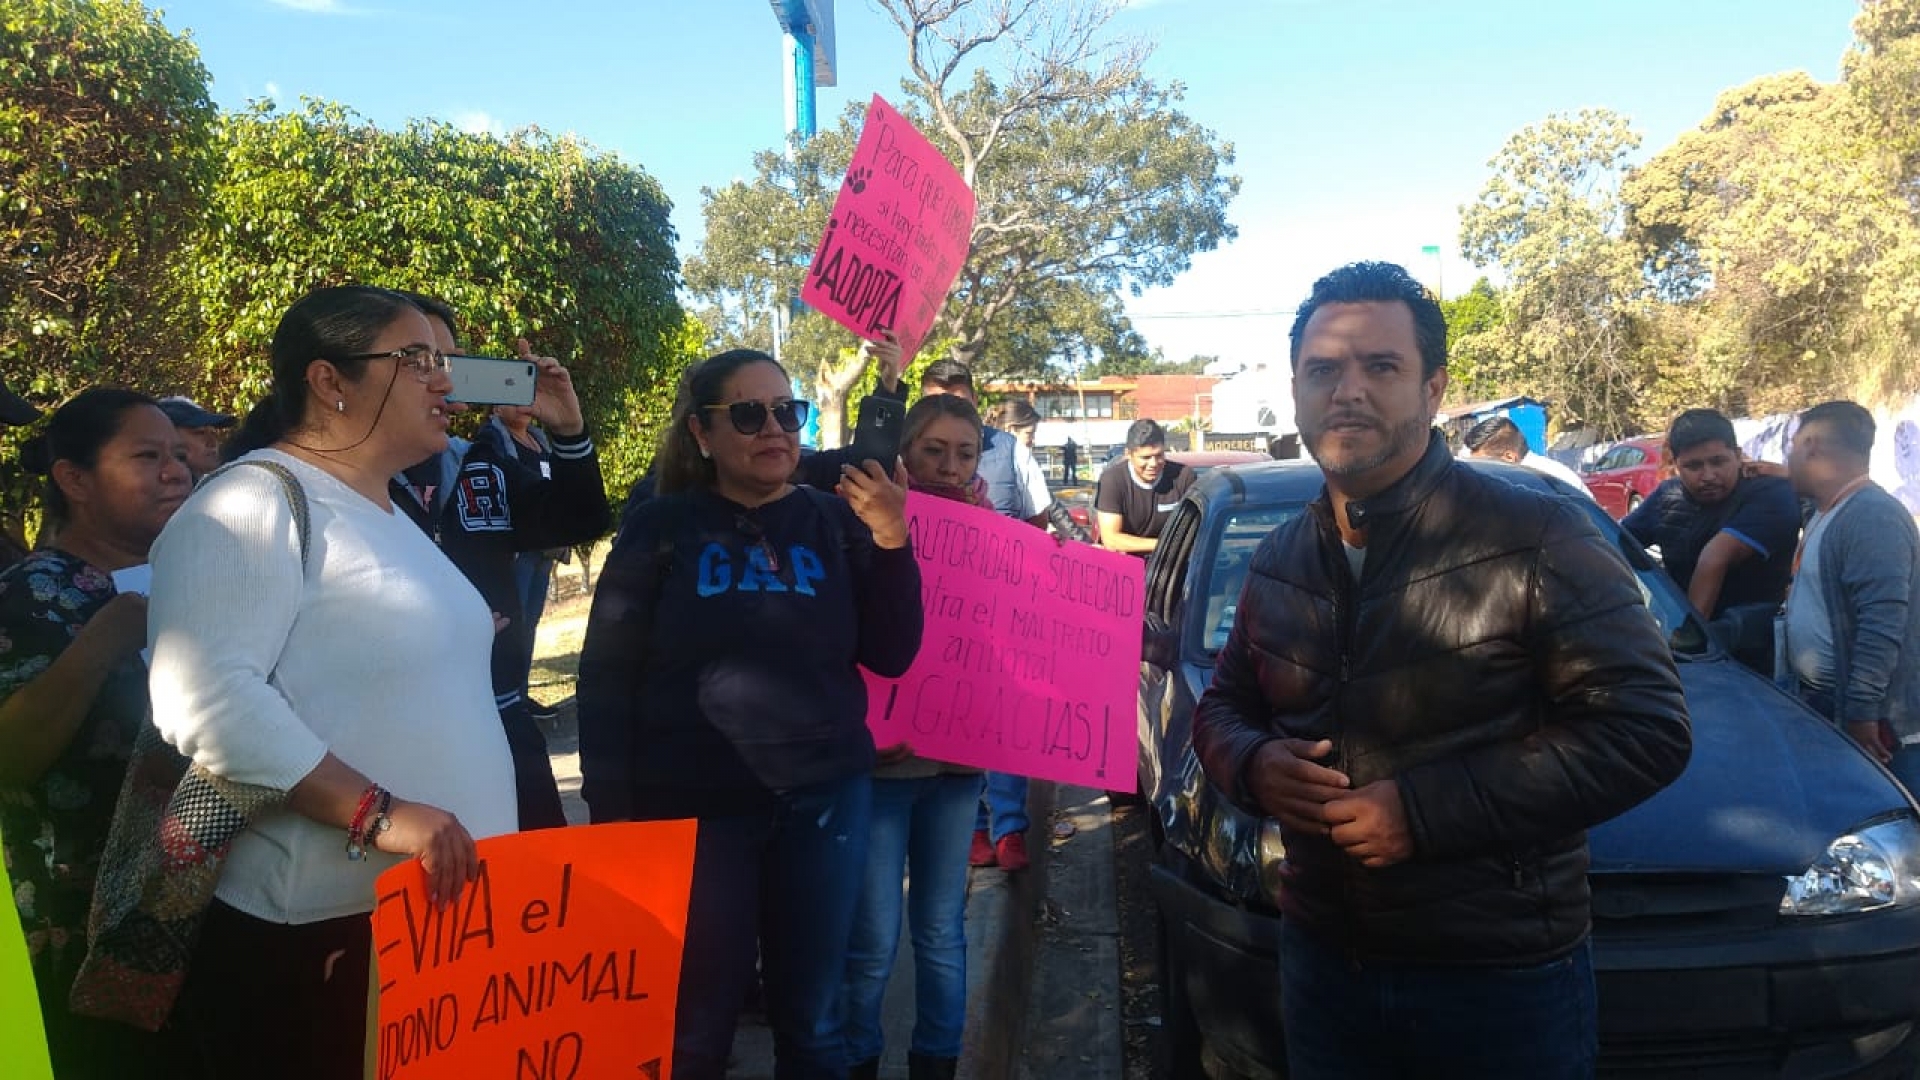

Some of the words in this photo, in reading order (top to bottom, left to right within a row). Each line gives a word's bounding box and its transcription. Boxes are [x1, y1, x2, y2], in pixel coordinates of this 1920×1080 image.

[843, 210, 909, 269] necesitan
[697, 542, 826, 597] GAP
[908, 514, 1025, 587] AUTORIDAD
[1048, 552, 1136, 618] SOCIEDAD
[971, 592, 998, 629] el
[1010, 607, 1111, 658] MALTRATO
[944, 634, 1057, 685] animal
[520, 863, 573, 934] el
[472, 948, 649, 1032] ANIMAL
[515, 1031, 583, 1080] NO
